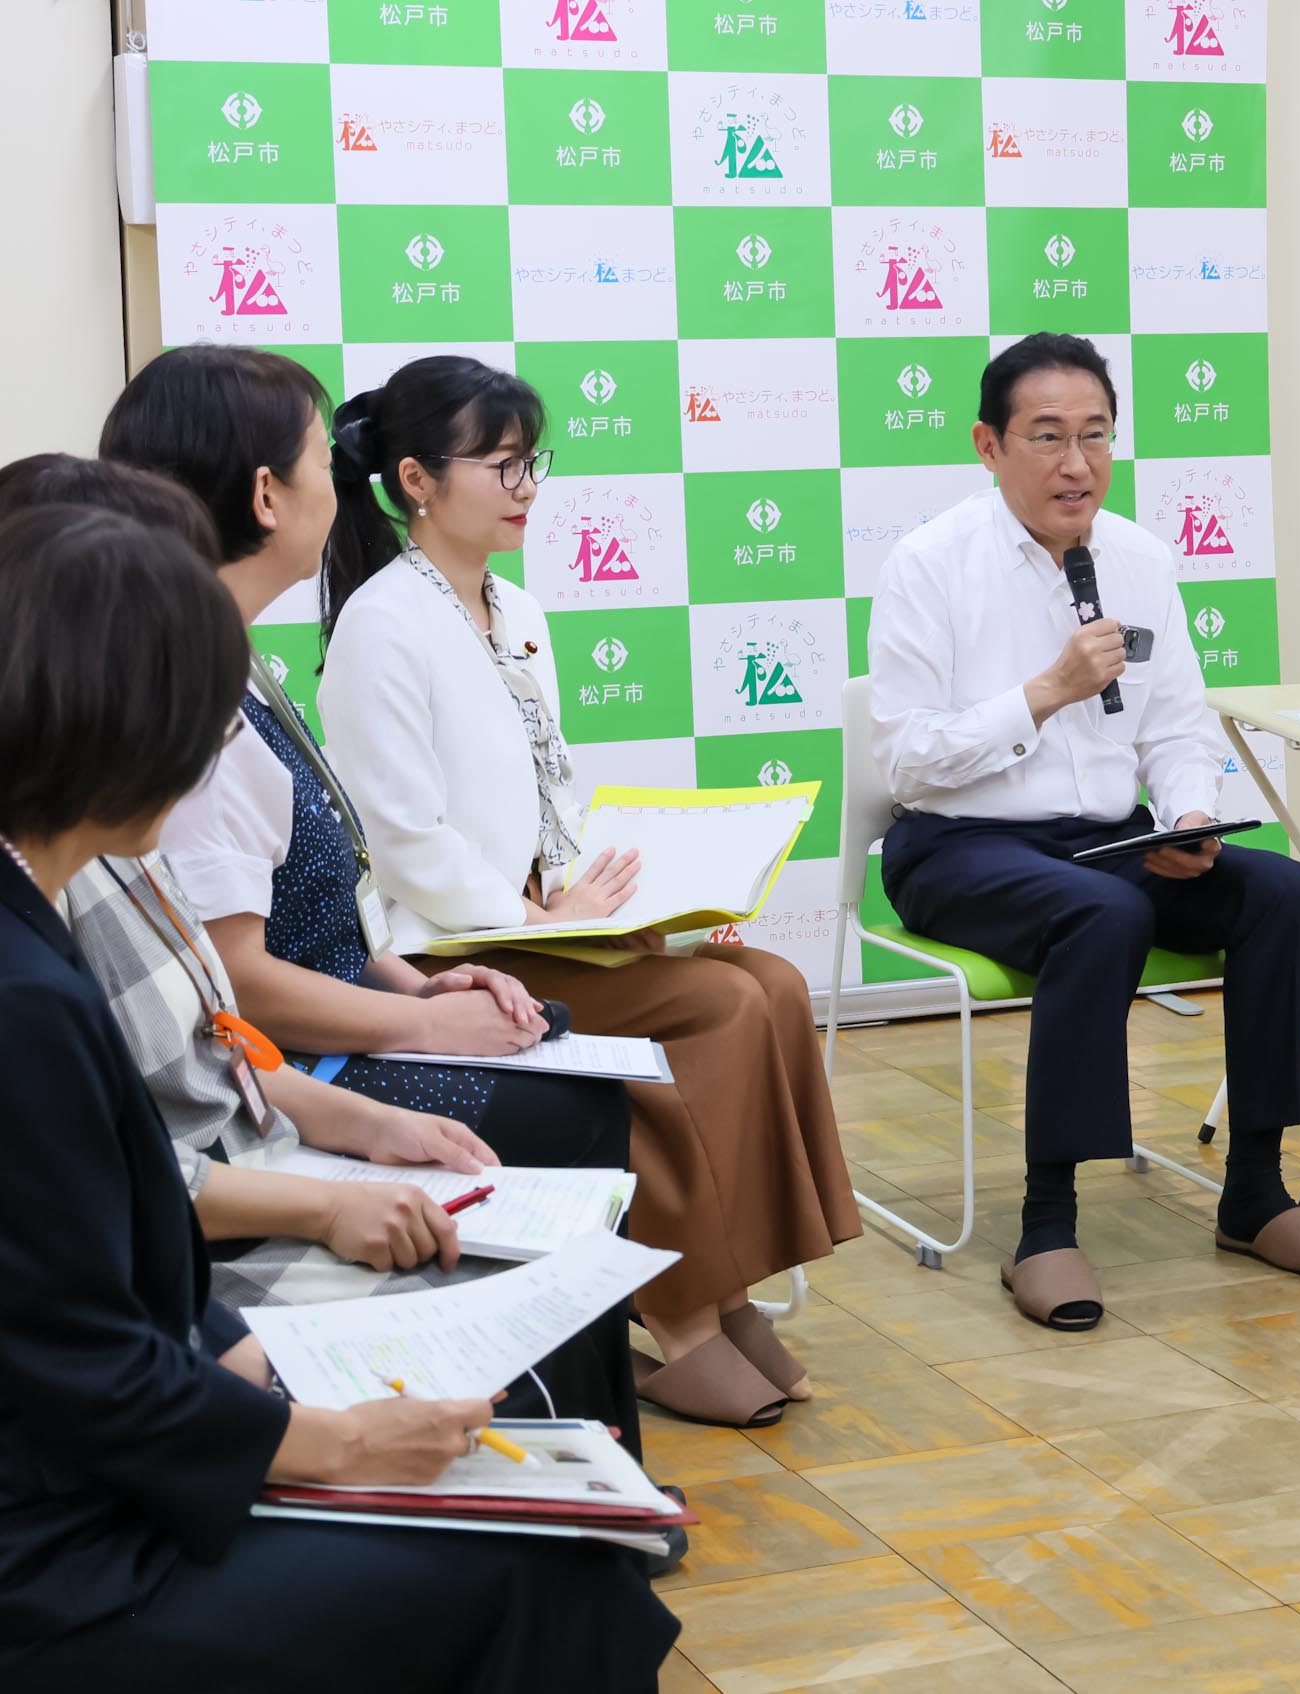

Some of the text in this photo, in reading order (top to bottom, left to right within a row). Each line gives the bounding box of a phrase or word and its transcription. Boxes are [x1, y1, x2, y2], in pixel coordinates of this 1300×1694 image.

[379, 4, 448, 26] 松戸市
[715, 13, 777, 35] 松戸市
[1026, 22, 1083, 42] 松戸市
[534, 47, 638, 58] matsudo
[1153, 62, 1242, 71] matsudo
[208, 141, 279, 163] 松戸市
[406, 140, 473, 150] matsudo
[1046, 148, 1100, 157] matsudo
[556, 146, 621, 167] 松戸市
[877, 149, 937, 170] 松戸市
[1170, 153, 1225, 172] 松戸市
[703, 185, 803, 195] matsudo
[392, 282, 460, 304] 松戸市
[724, 281, 786, 301] 松戸市
[1033, 279, 1088, 298] 松戸市
[196, 321, 310, 332] matsudo
[865, 315, 962, 326] matsudo
[747, 408, 809, 420] matsudo
[885, 409, 945, 430] 松戸市
[1174, 402, 1229, 423] 松戸市
[568, 416, 631, 438] 松戸市
[734, 544, 796, 565] 松戸市
[1177, 560, 1252, 571] atsudo
[557, 586, 660, 599] matsudo
[1198, 649, 1239, 669] 戸市
[579, 683, 643, 706] 松戸市
[724, 709, 823, 723] matsudo
[769, 929, 830, 941] matsudo
